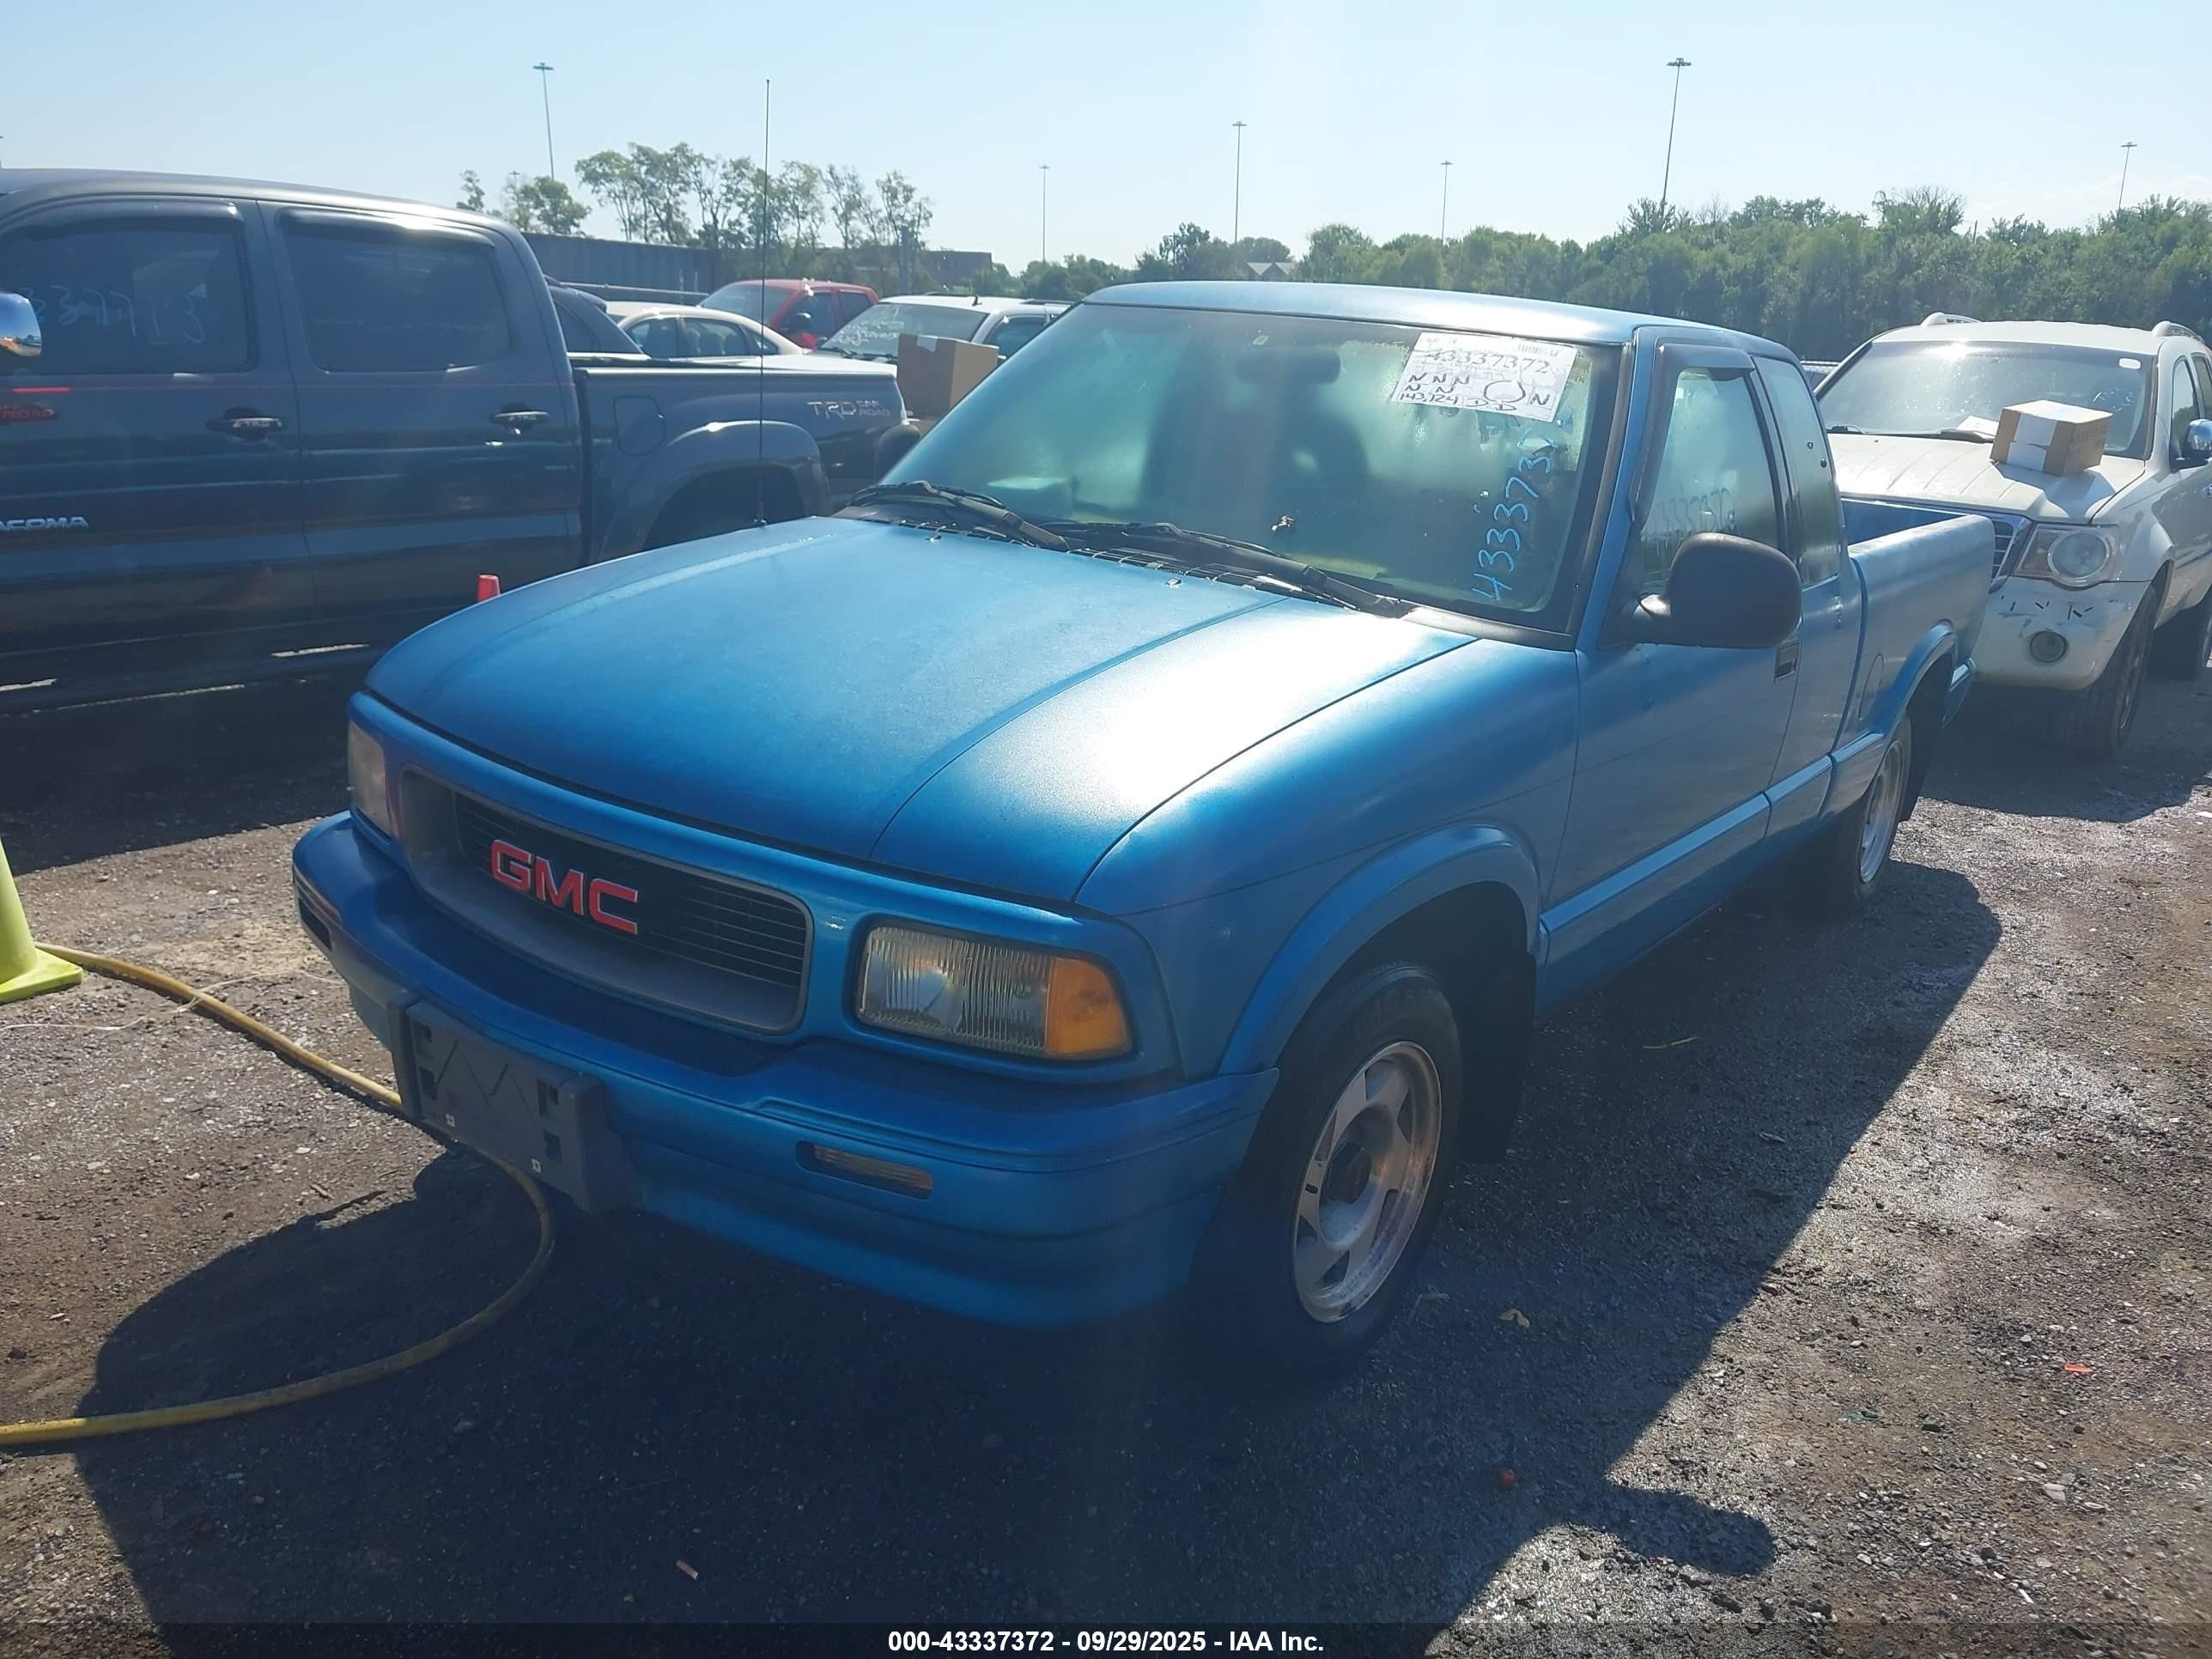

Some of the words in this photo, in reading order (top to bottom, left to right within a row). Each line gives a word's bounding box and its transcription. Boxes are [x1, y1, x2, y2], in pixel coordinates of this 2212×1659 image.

[1432, 373, 1448, 384] N
[1530, 393, 1551, 405] N
[808, 401, 857, 419] TRD
[491, 839, 638, 935] GMC
